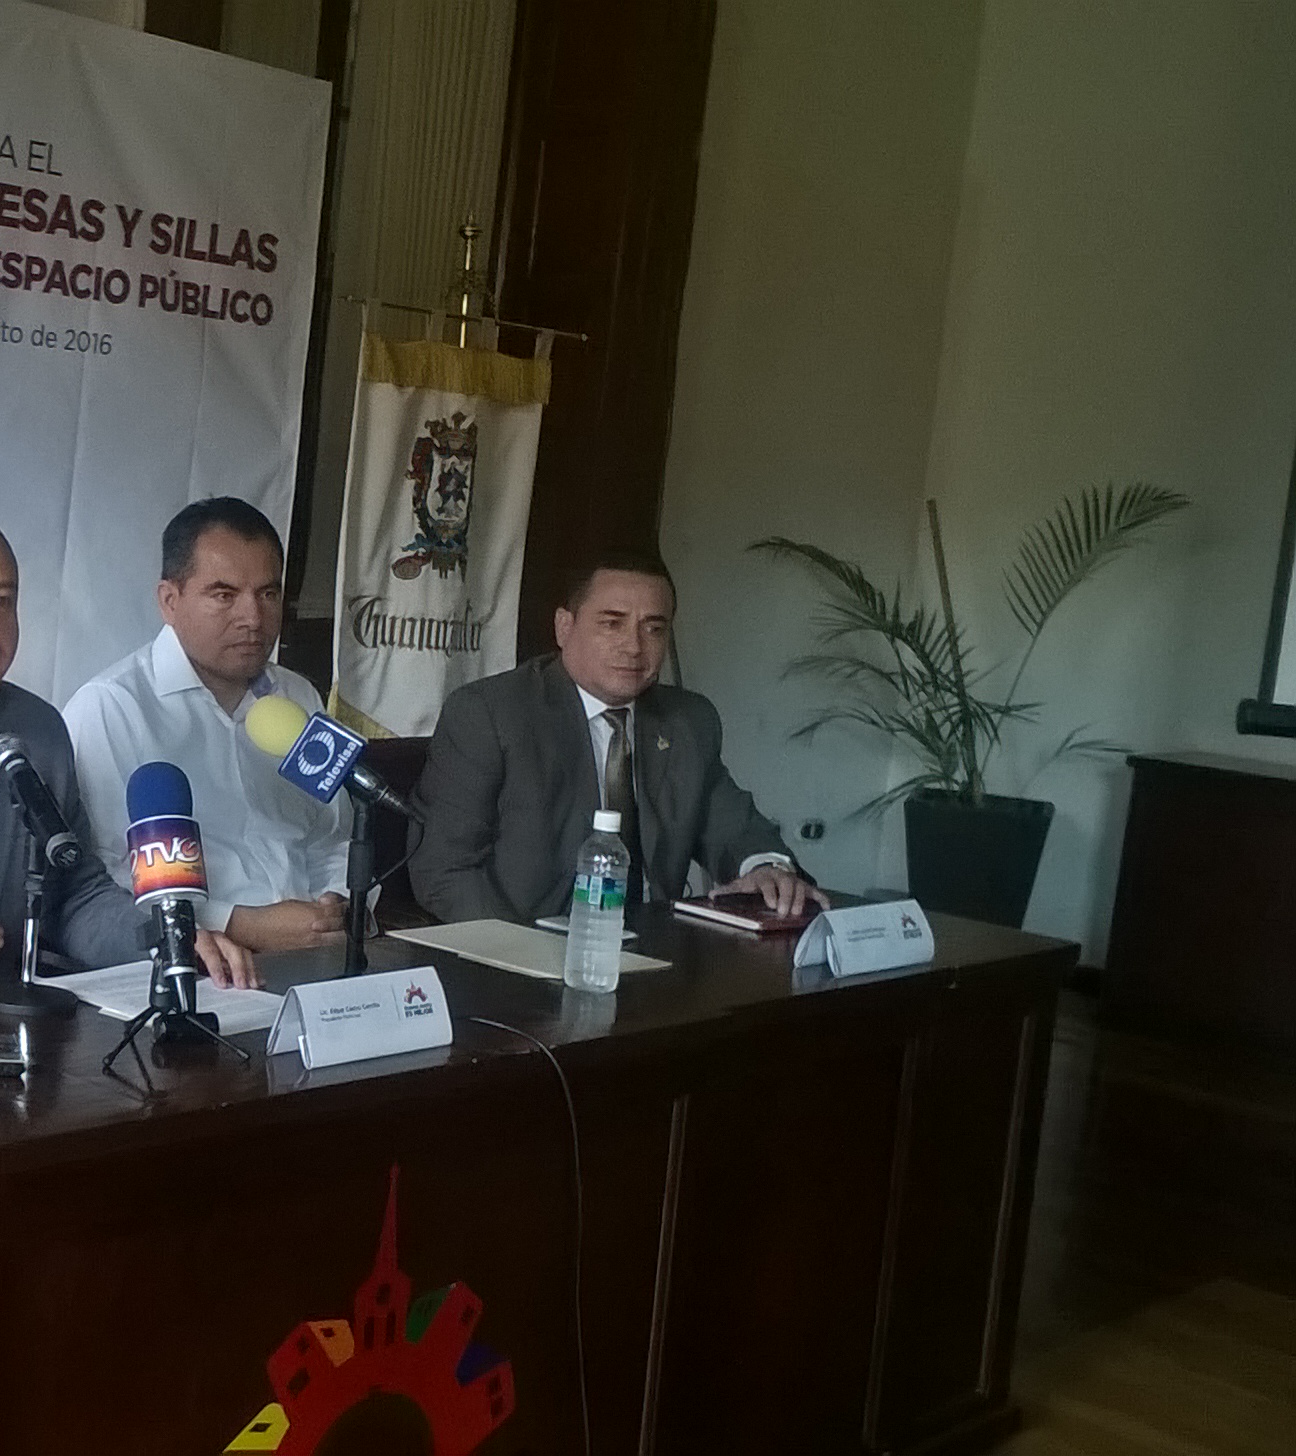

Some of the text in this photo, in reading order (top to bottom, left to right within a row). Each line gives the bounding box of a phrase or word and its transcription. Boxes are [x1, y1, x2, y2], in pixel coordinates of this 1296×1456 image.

[27, 140, 63, 177] EL
[116, 204, 144, 249] Y
[149, 212, 280, 274] SILLAS
[138, 270, 275, 327] PÚBLICO
[30, 324, 58, 349] de
[63, 328, 114, 356] 2016
[316, 741, 358, 792] Televisa
